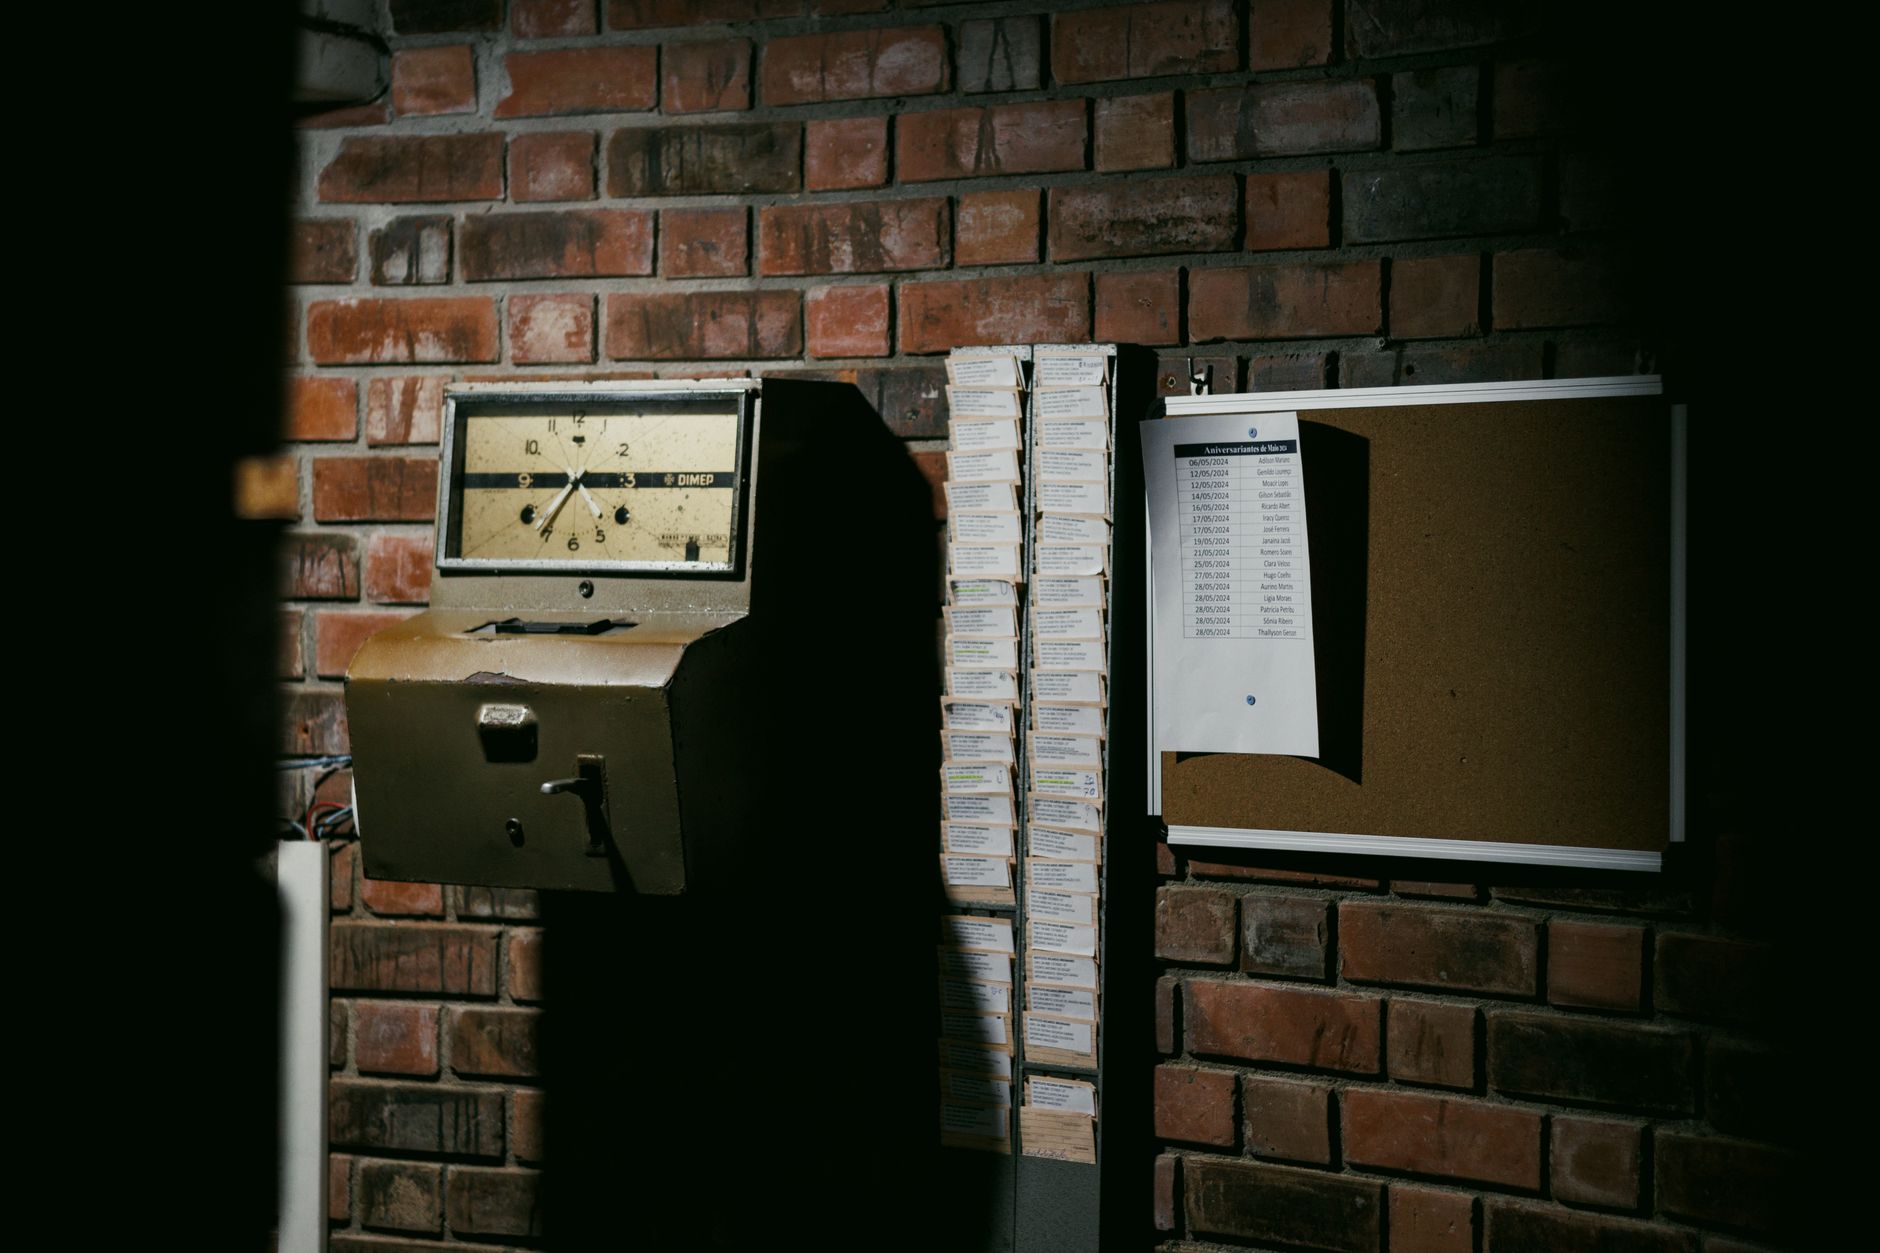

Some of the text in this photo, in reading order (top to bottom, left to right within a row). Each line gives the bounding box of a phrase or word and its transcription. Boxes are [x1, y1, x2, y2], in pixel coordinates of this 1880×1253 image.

[572, 410, 586, 423] 12
[548, 419, 556, 432] 11
[525, 440, 538, 455] 10
[620, 443, 630, 456] 2
[1204, 444, 1260, 454] Aniversariantes
[1260, 444, 1268, 452] de
[1189, 458, 1228, 467] 06/05/2024
[1190, 470, 1228, 478] 12/05/2024
[518, 473, 530, 488] 9
[624, 473, 636, 488] 3
[678, 474, 714, 486] DIMEP
[1192, 481, 1229, 489] 12/05/2024
[1192, 492, 1229, 500] 14/05/2024
[1192, 504, 1230, 512] 16/05/2024
[1193, 515, 1230, 523] 17/05/2024
[1194, 526, 1230, 534] 17/05/2024
[595, 530, 606, 544] 5
[568, 538, 580, 552] 6
[1194, 538, 1230, 546] 19/05/2024
[1194, 549, 1230, 557] 21/05/2024
[1194, 560, 1230, 568] 25/05/2024
[1194, 583, 1230, 591] 28/05/2024
